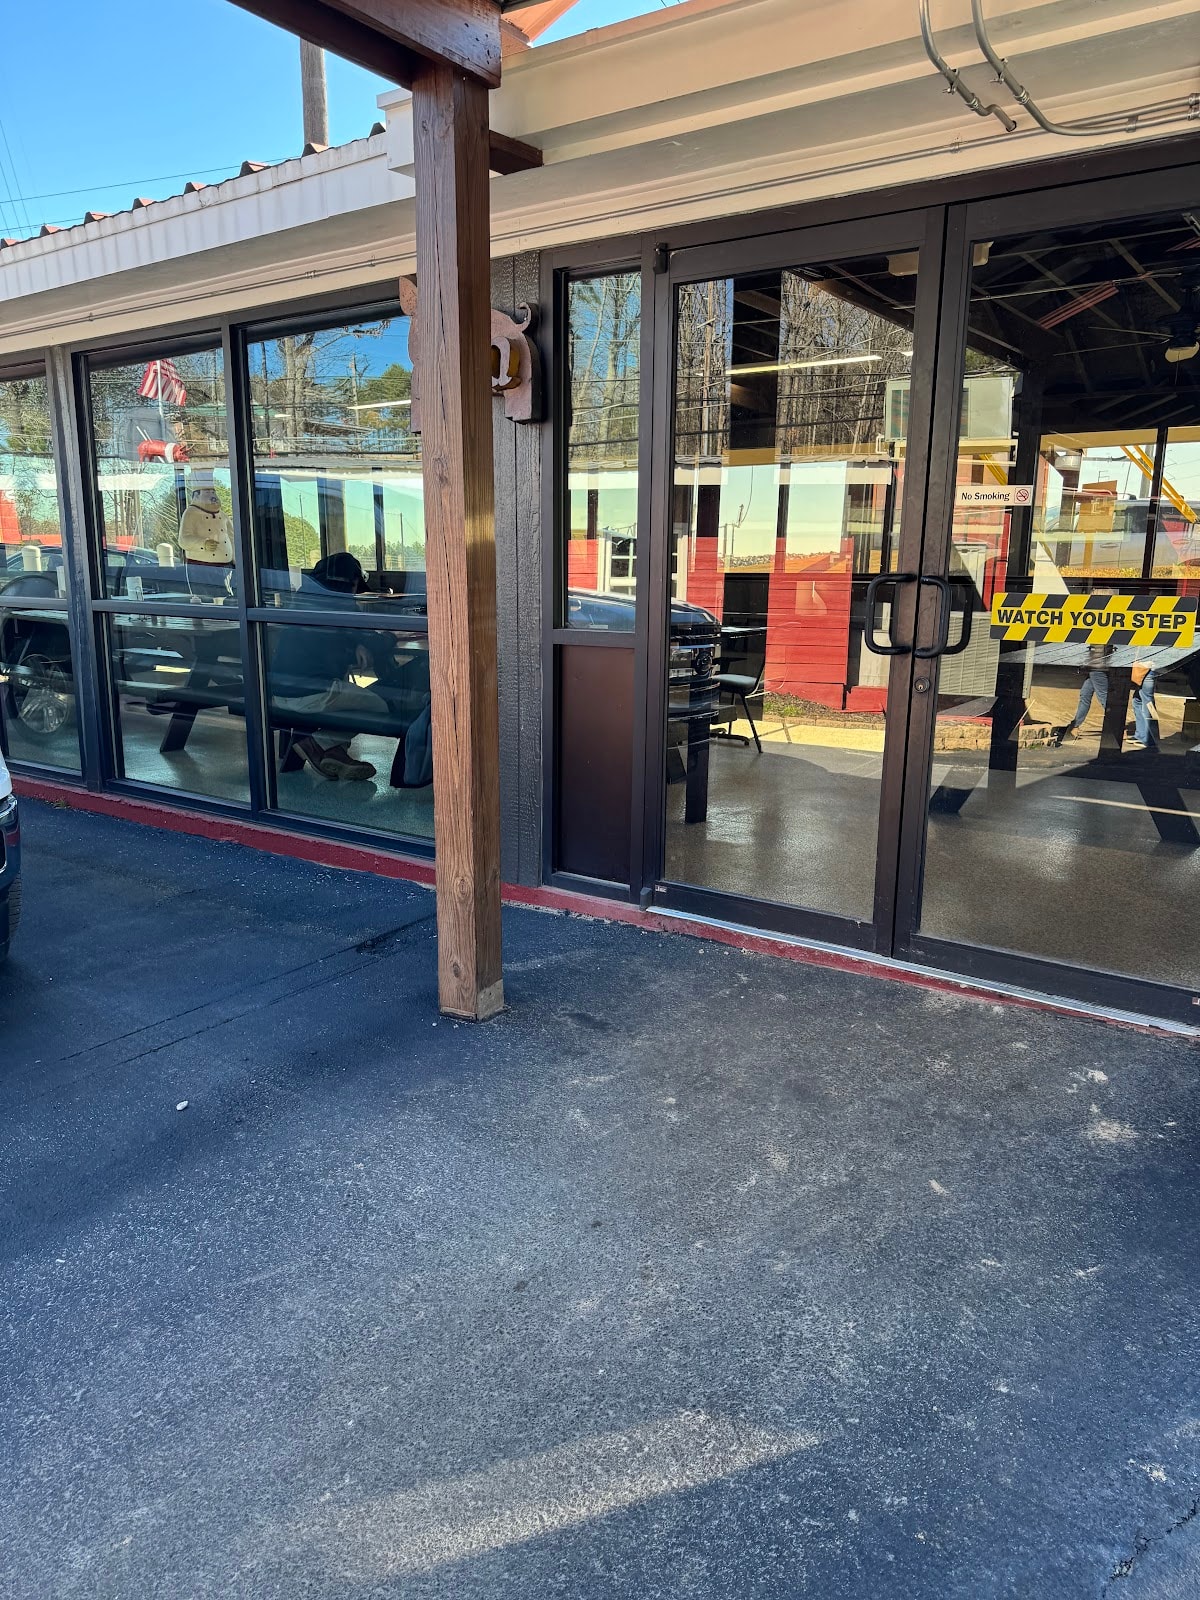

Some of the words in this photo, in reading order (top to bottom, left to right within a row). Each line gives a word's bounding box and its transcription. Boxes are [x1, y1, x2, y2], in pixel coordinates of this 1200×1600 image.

[961, 492, 973, 500] No
[974, 492, 1011, 502] Smoking
[997, 609, 1063, 626] WATCH
[1070, 612, 1125, 628] YOUR
[1132, 613, 1187, 630] STEP
